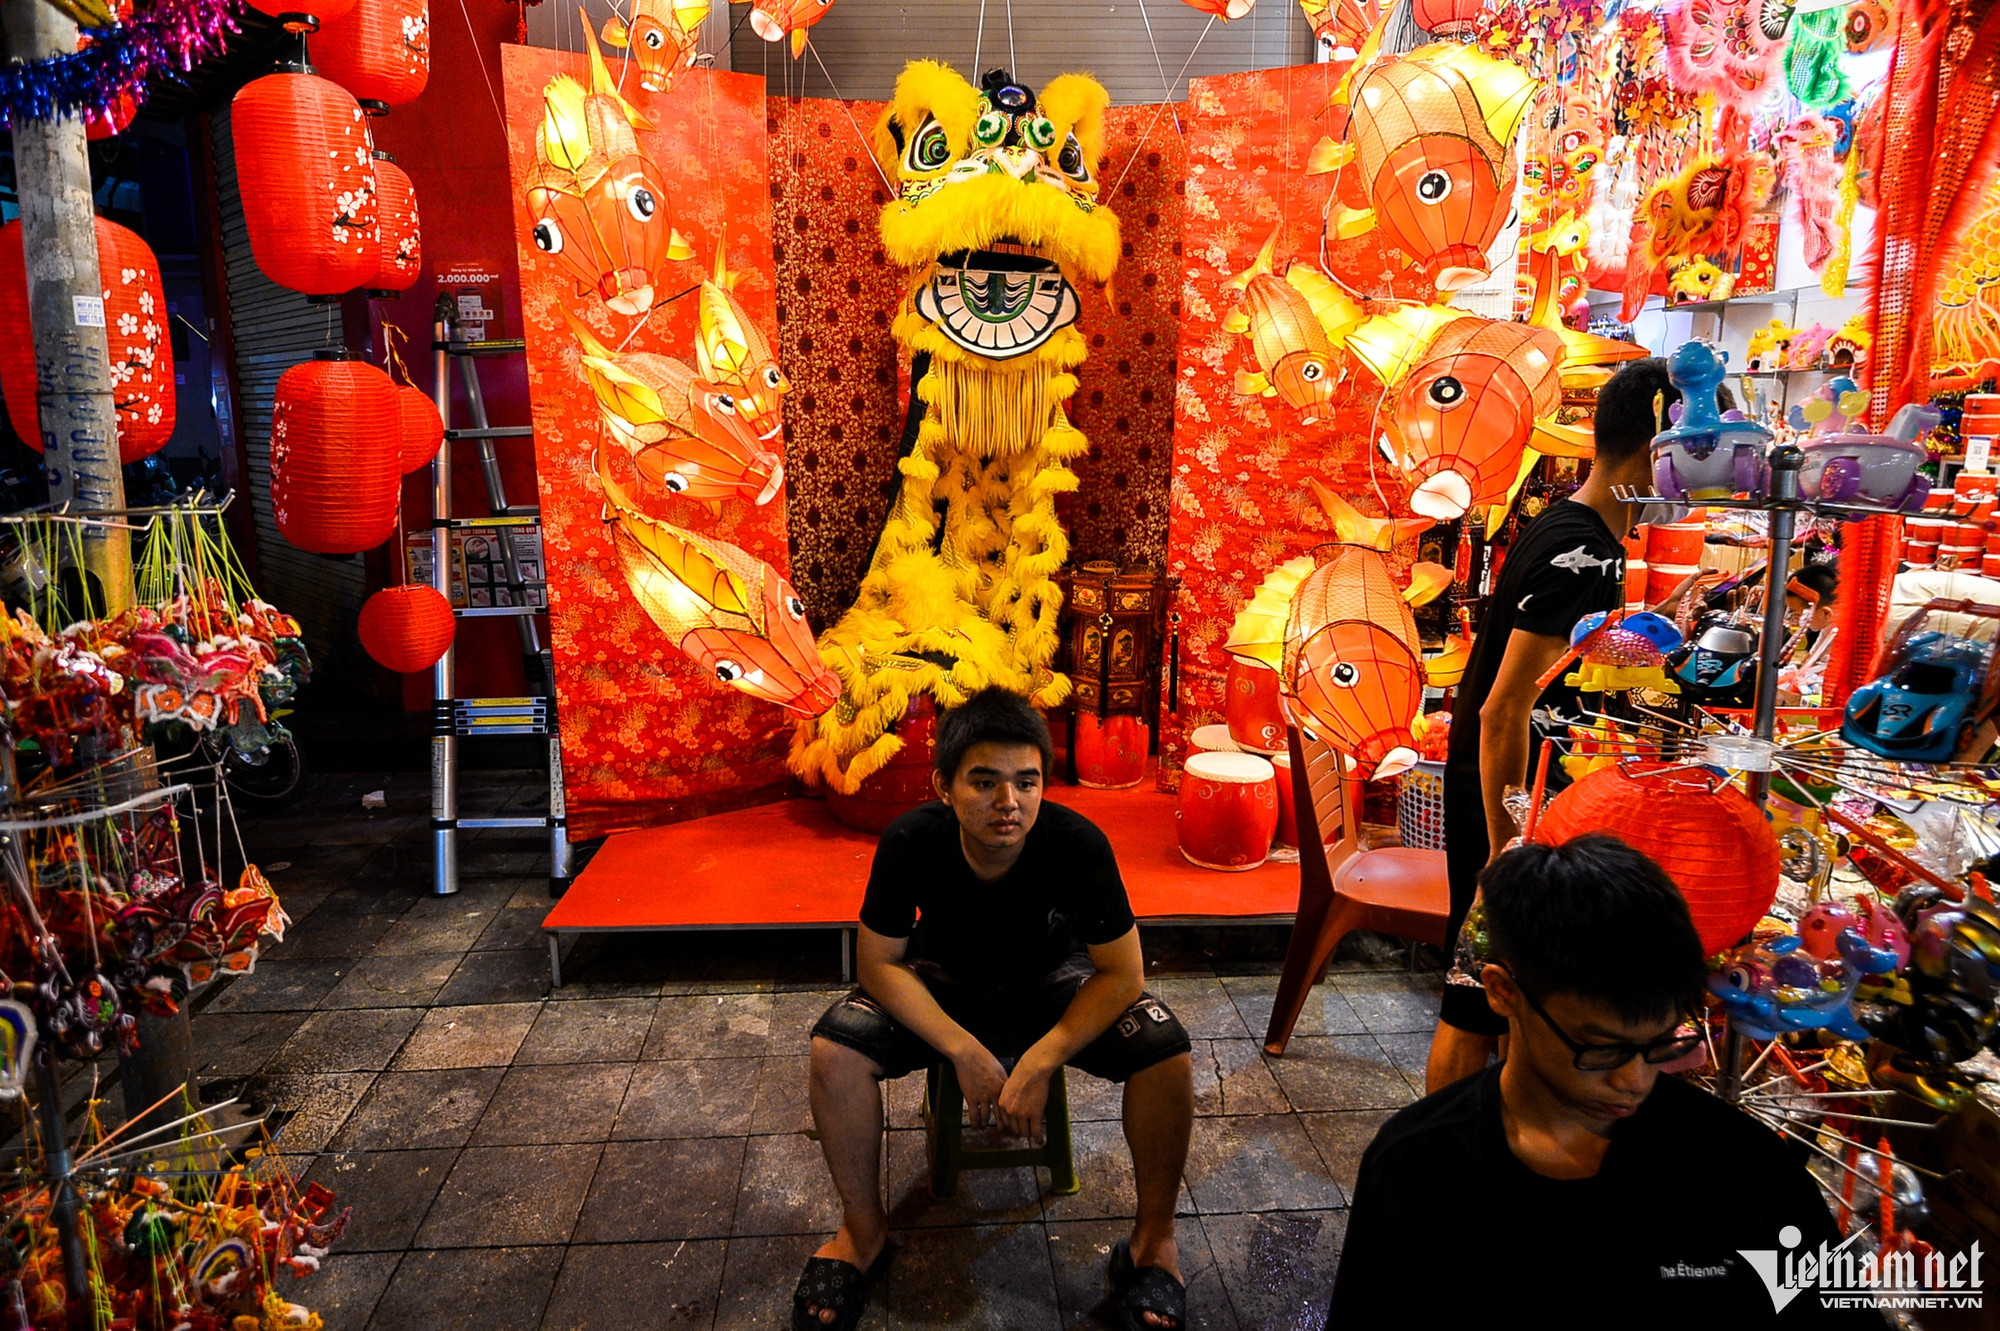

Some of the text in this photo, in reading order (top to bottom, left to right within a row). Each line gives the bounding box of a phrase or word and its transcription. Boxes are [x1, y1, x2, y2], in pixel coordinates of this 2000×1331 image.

[437, 274, 490, 283] 2.000.000
[1152, 1008, 1164, 1020] 2
[1122, 1020, 1135, 1034] D
